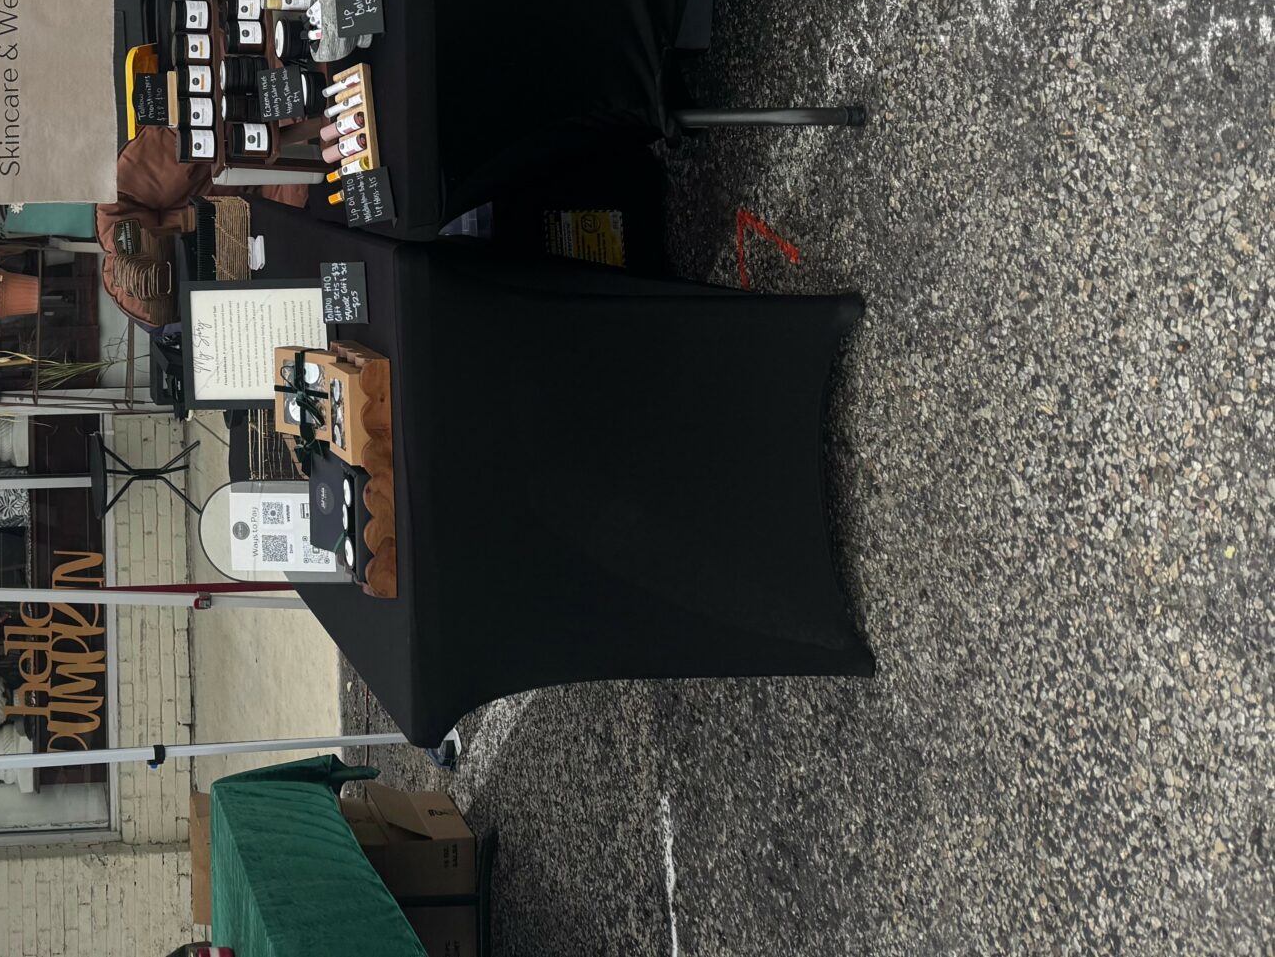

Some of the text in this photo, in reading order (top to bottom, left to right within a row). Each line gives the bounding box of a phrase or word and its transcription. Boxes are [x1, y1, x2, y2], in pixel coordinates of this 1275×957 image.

[341, 9, 355, 30] Lip
[263, 92, 271, 118] Eczema
[349, 208, 361, 222] Lip
[325, 298, 334, 322] Tallow
[193, 319, 215, 374] My Story
[251, 506, 259, 523] Pay
[251, 524, 258, 533] to
